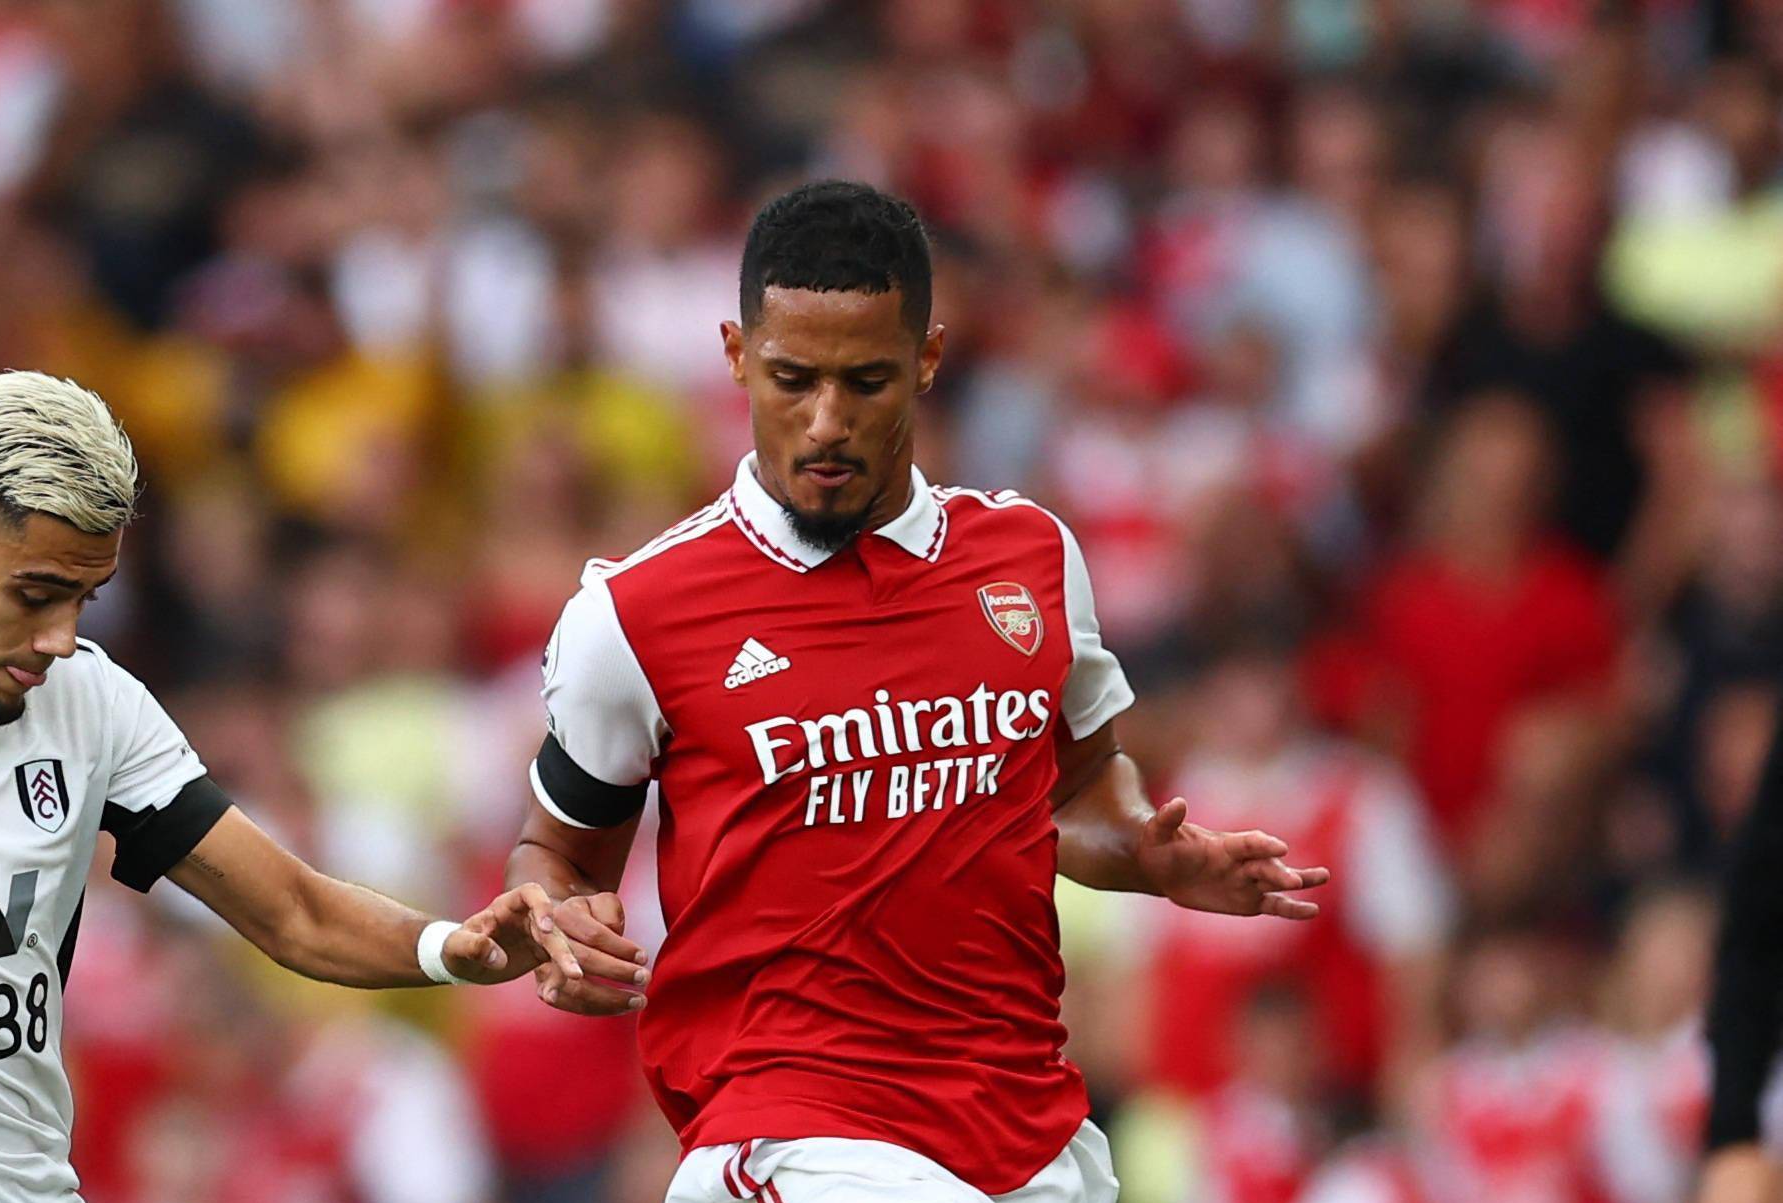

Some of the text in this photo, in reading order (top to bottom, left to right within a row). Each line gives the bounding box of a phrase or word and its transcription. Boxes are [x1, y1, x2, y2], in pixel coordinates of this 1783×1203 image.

[724, 656, 792, 690] adidas
[744, 681, 1051, 785] Emirates
[30, 768, 58, 819] FFC
[804, 769, 874, 826] FLY
